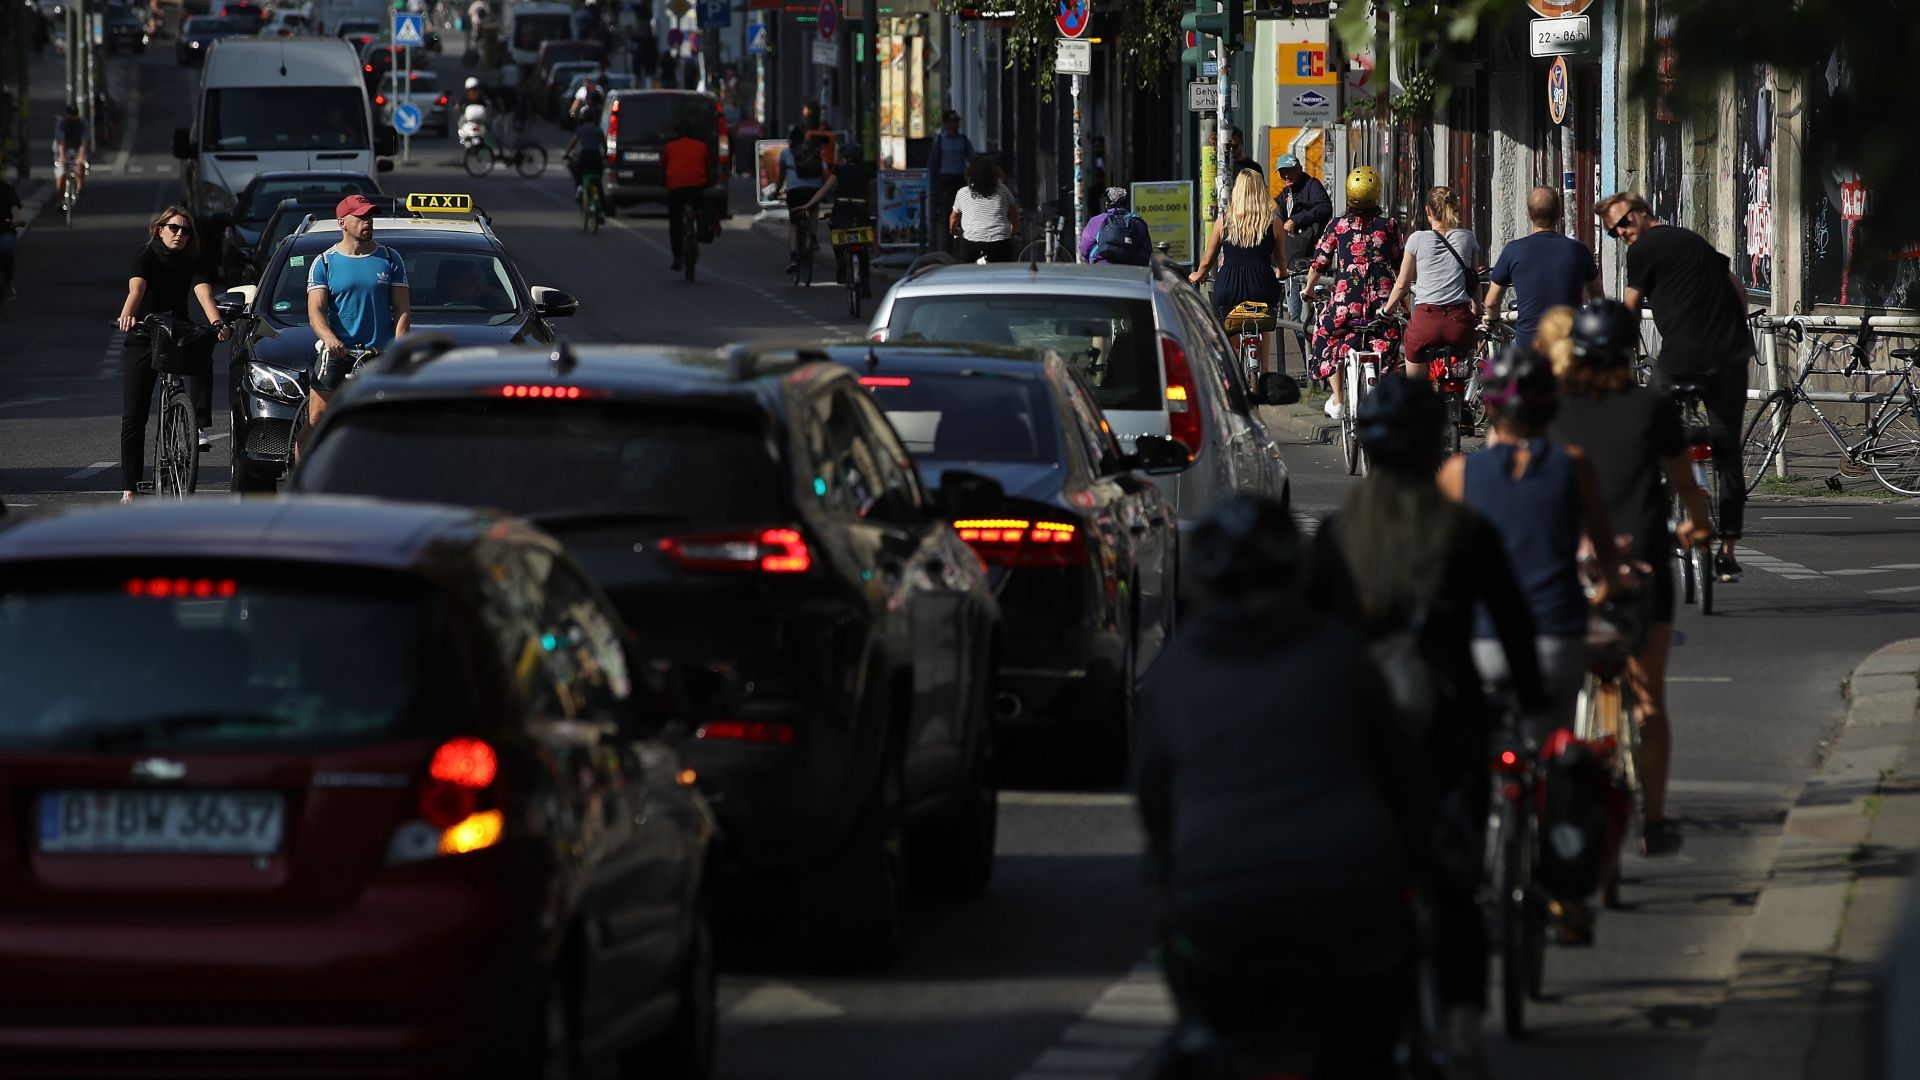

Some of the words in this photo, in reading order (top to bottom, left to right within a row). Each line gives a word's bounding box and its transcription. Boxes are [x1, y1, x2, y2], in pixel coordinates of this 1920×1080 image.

[1539, 33, 1550, 43] 22
[1564, 31, 1575, 41] 06
[418, 196, 461, 207] TAXI
[1136, 203, 1182, 212] 90.000.000
[65, 796, 87, 835] B
[116, 796, 167, 835] BW
[177, 797, 277, 838] 3637
